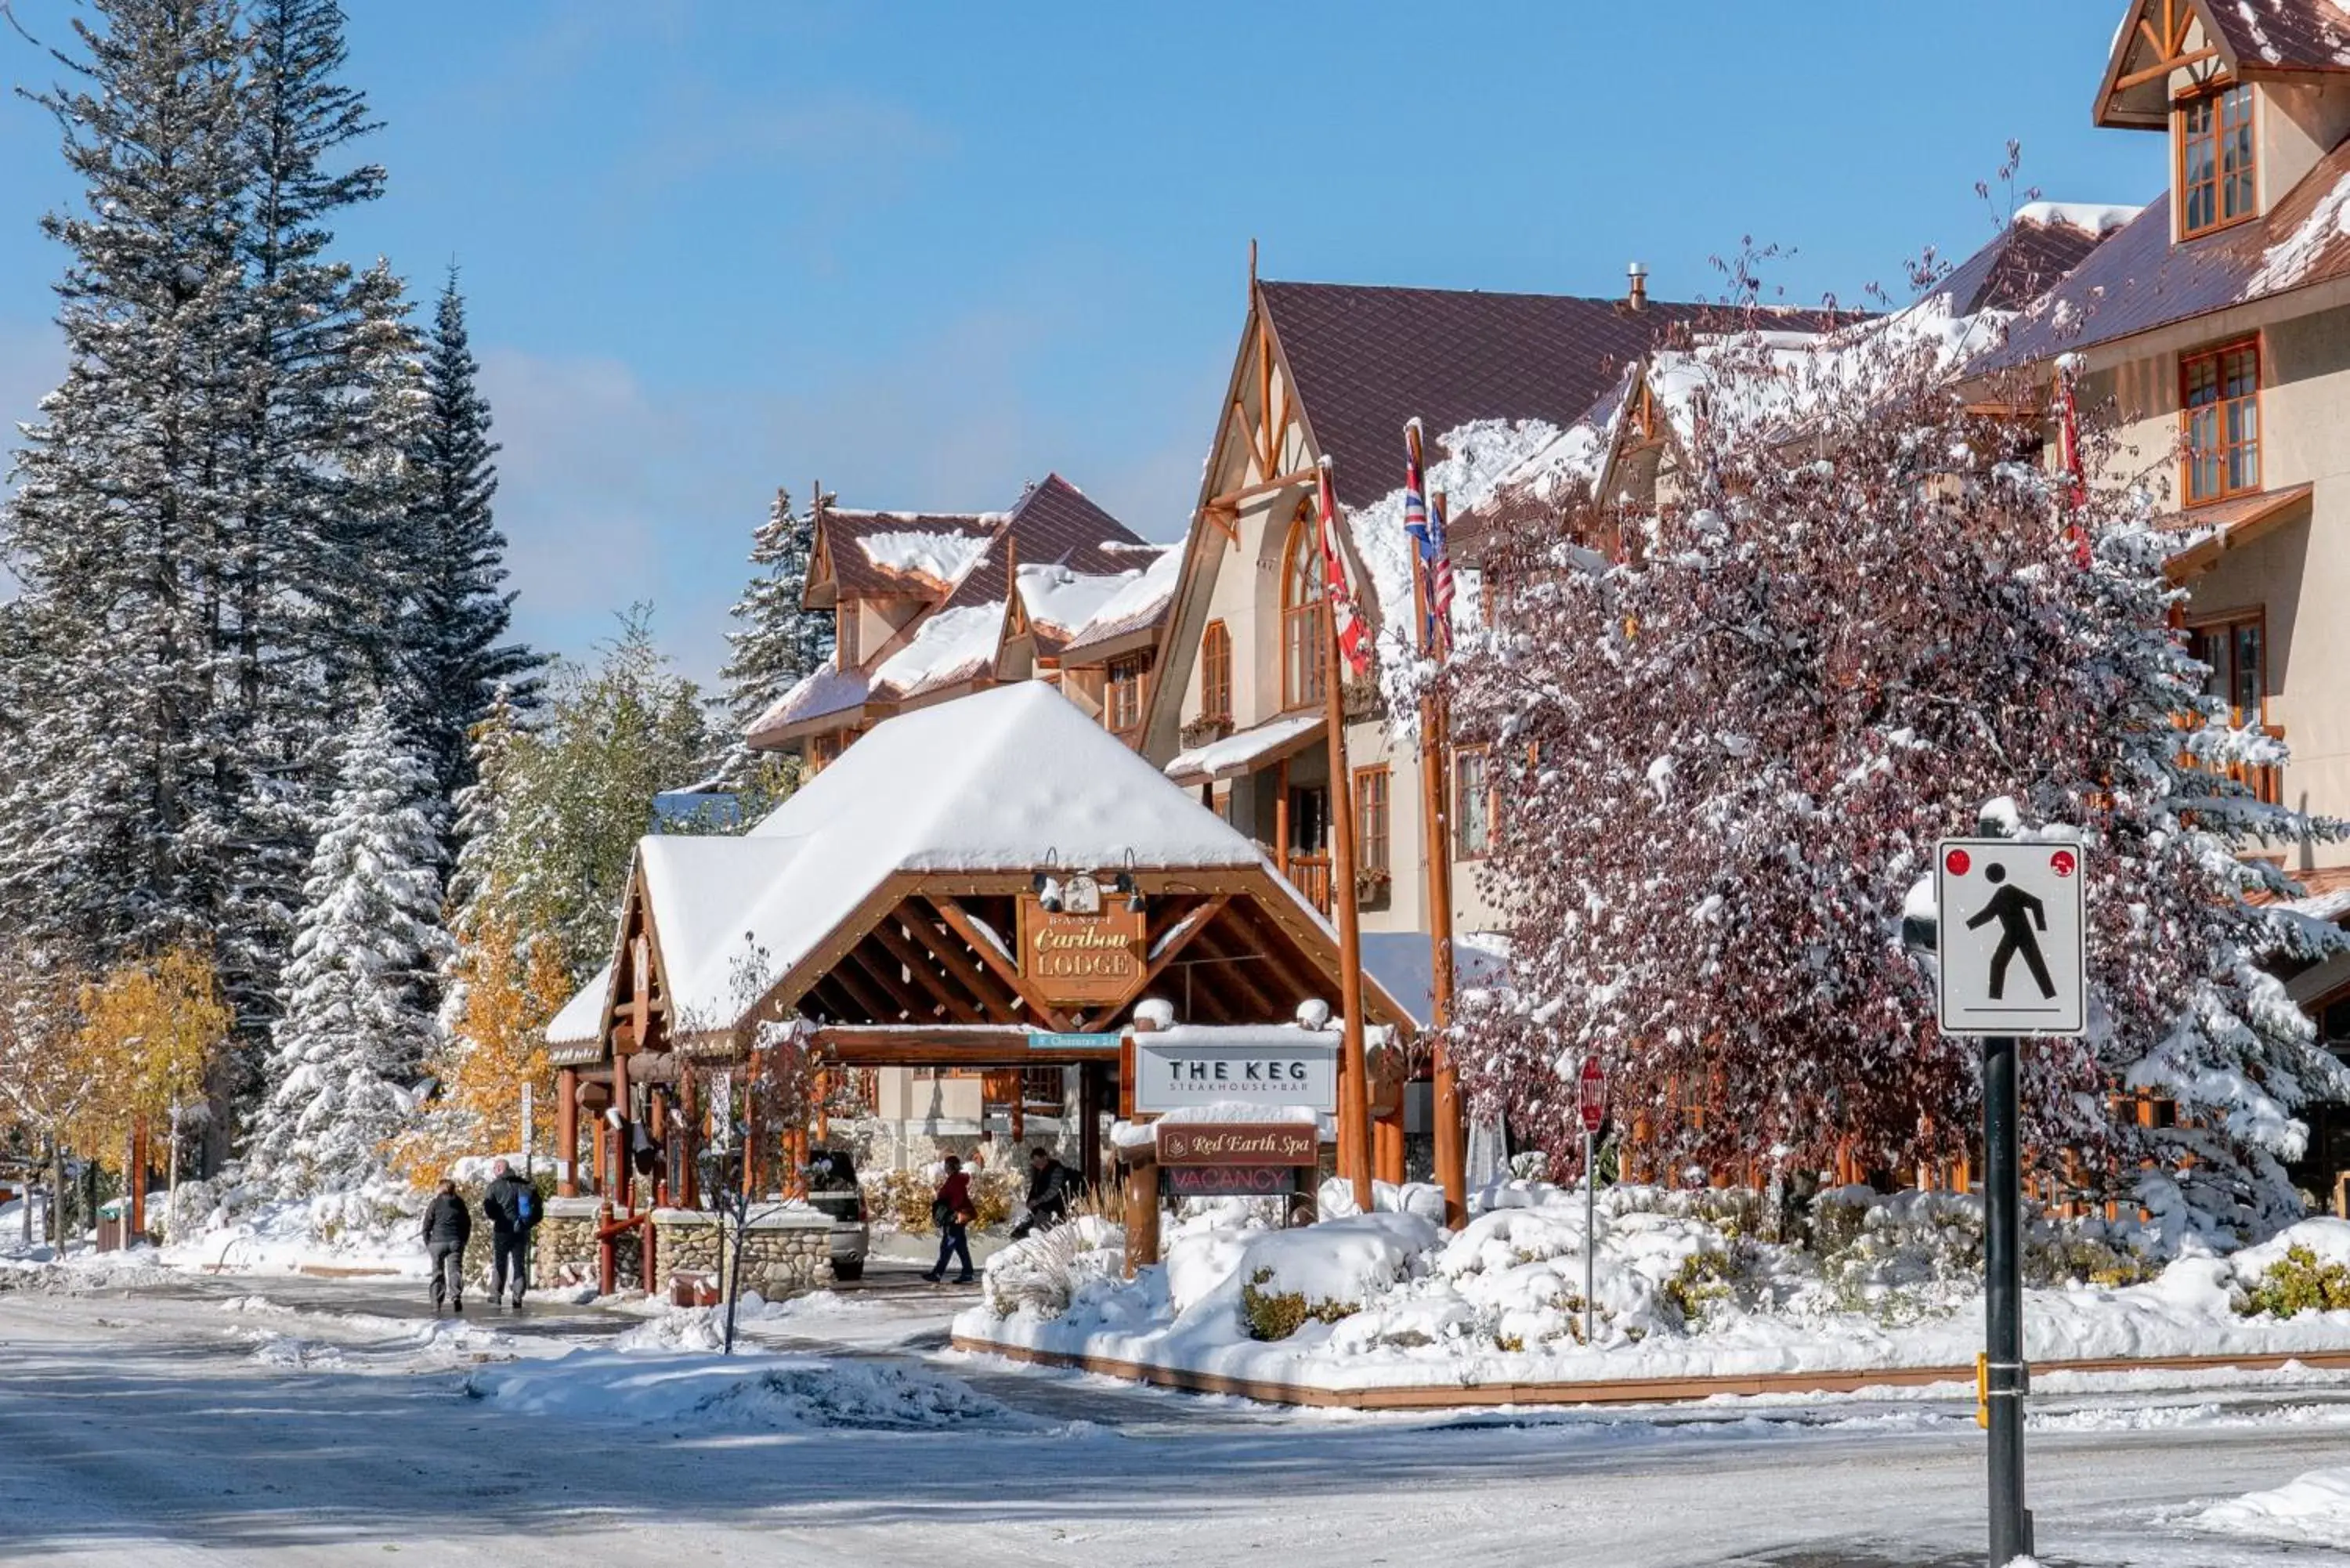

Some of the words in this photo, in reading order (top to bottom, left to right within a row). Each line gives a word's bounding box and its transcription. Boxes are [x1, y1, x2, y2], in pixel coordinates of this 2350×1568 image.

[1034, 925, 1129, 952] Caribou
[1037, 955, 1129, 977] LODGE
[1169, 1061, 1229, 1080] THE
[1246, 1061, 1307, 1080] KEG
[1582, 1078, 1603, 1107] STOP
[1191, 1133, 1227, 1155] Red
[1227, 1133, 1276, 1153] Earth
[1278, 1135, 1310, 1157] Spa
[1171, 1168, 1287, 1189] VACANCY
